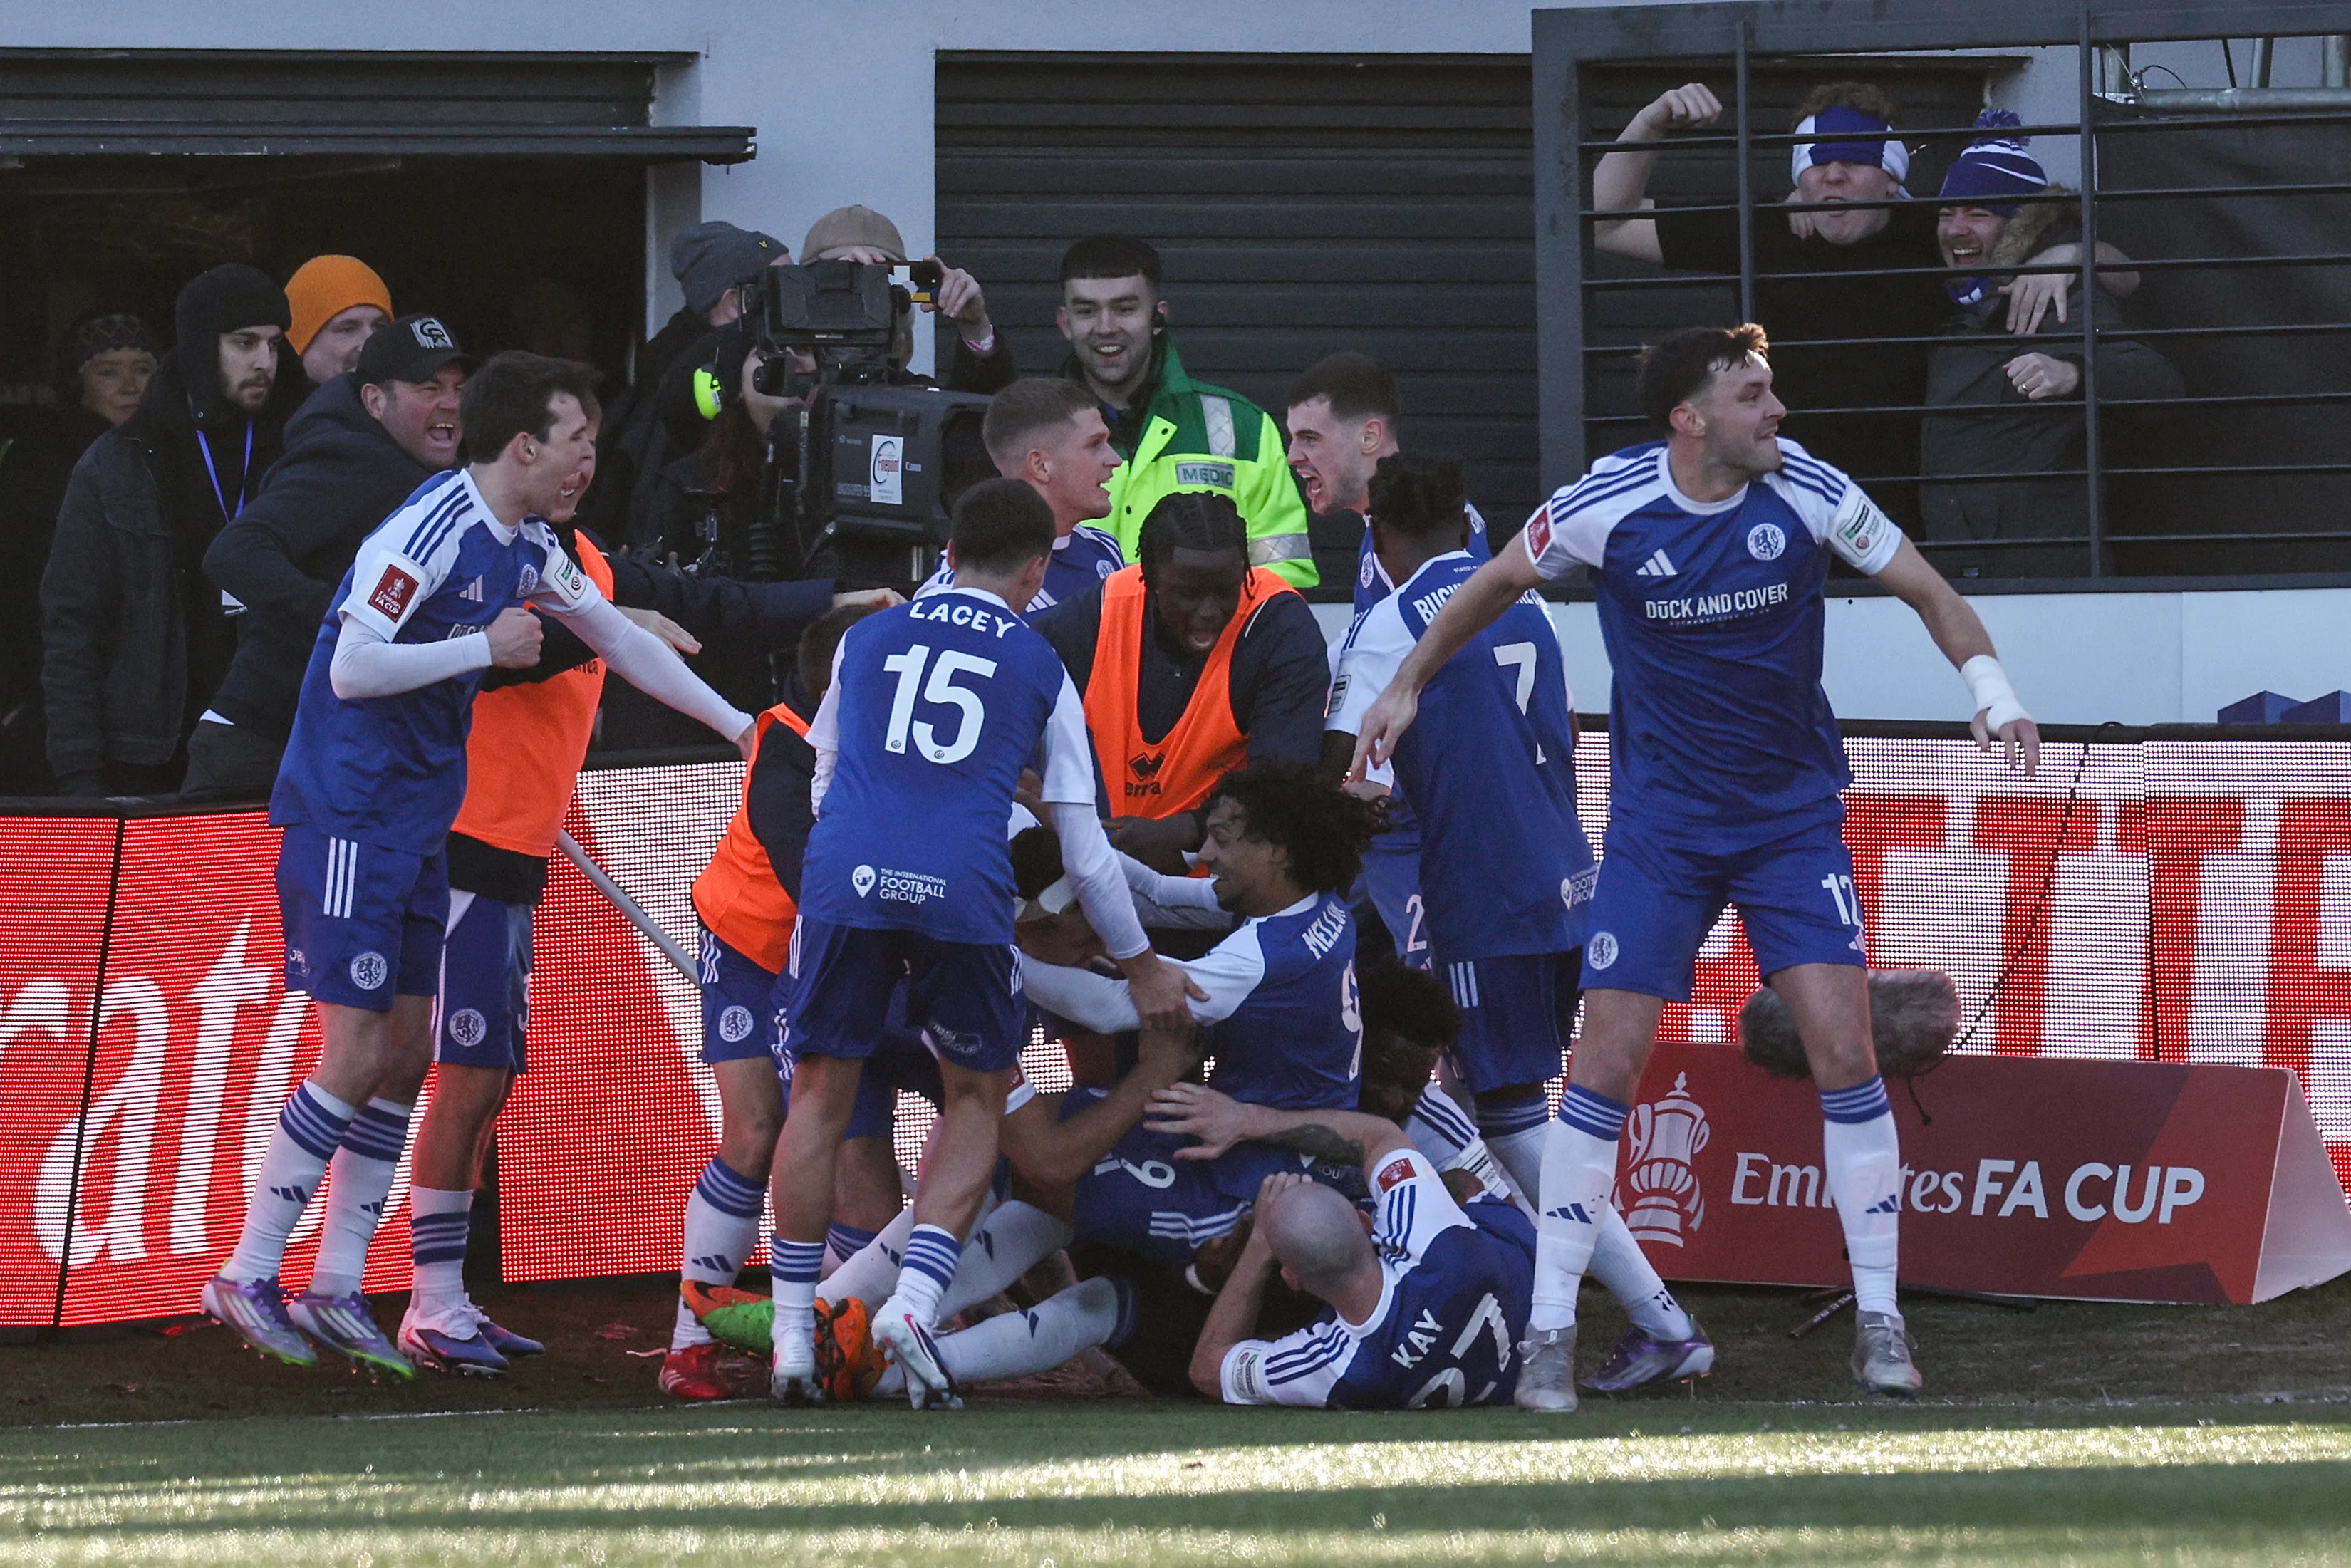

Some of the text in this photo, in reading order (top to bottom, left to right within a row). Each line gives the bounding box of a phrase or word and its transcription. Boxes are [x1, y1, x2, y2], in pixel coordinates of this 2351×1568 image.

[1183, 467, 1233, 486] MEDIC
[384, 601, 400, 614] CUP
[1697, 593, 1731, 616] AND
[1735, 583, 1789, 611] COVER
[909, 601, 1017, 638] LACEY
[883, 643, 998, 764] 15
[1493, 641, 1547, 765] 7
[880, 876, 945, 899] FOOTBALL
[881, 868, 947, 886] THE INTERNATIONAL
[879, 888, 926, 905] GROUP
[1971, 1158, 2049, 1219] FA
[2065, 1162, 2206, 1224] CUP
[1391, 1308, 1444, 1370] KAY
